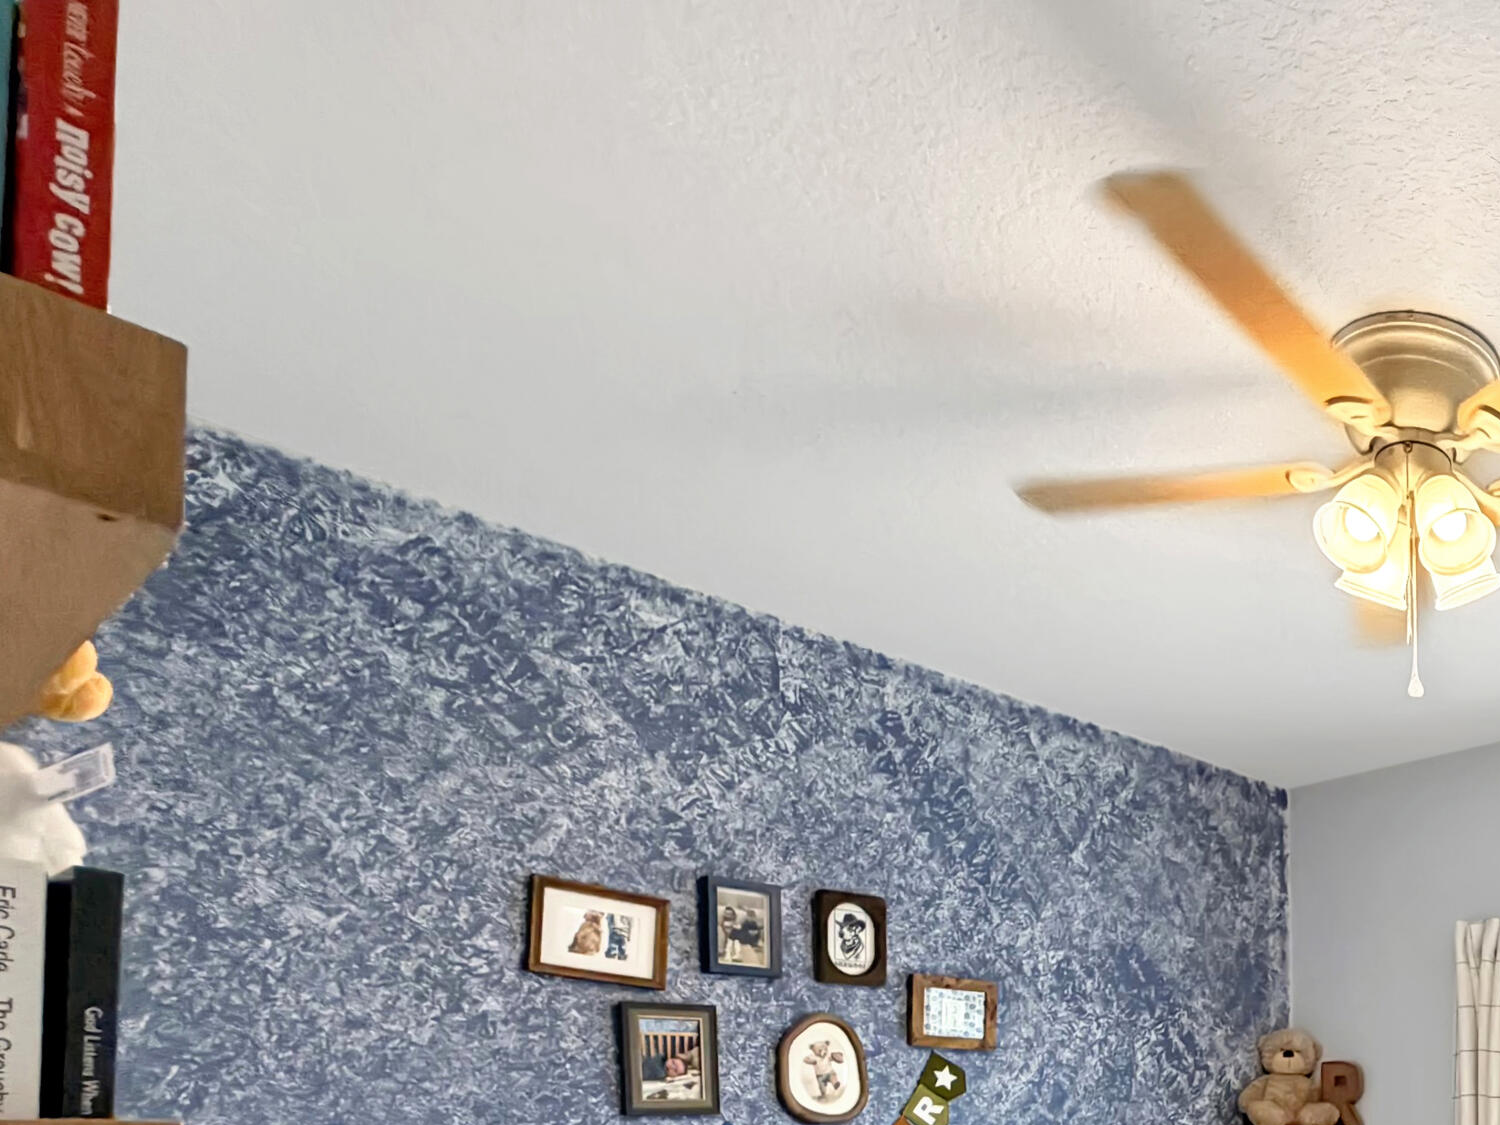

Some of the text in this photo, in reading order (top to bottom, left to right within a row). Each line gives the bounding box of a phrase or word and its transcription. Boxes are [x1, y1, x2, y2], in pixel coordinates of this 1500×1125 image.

[49, 117, 93, 215] noisy
[44, 212, 86, 295] cow!
[83, 1005, 104, 1033] God
